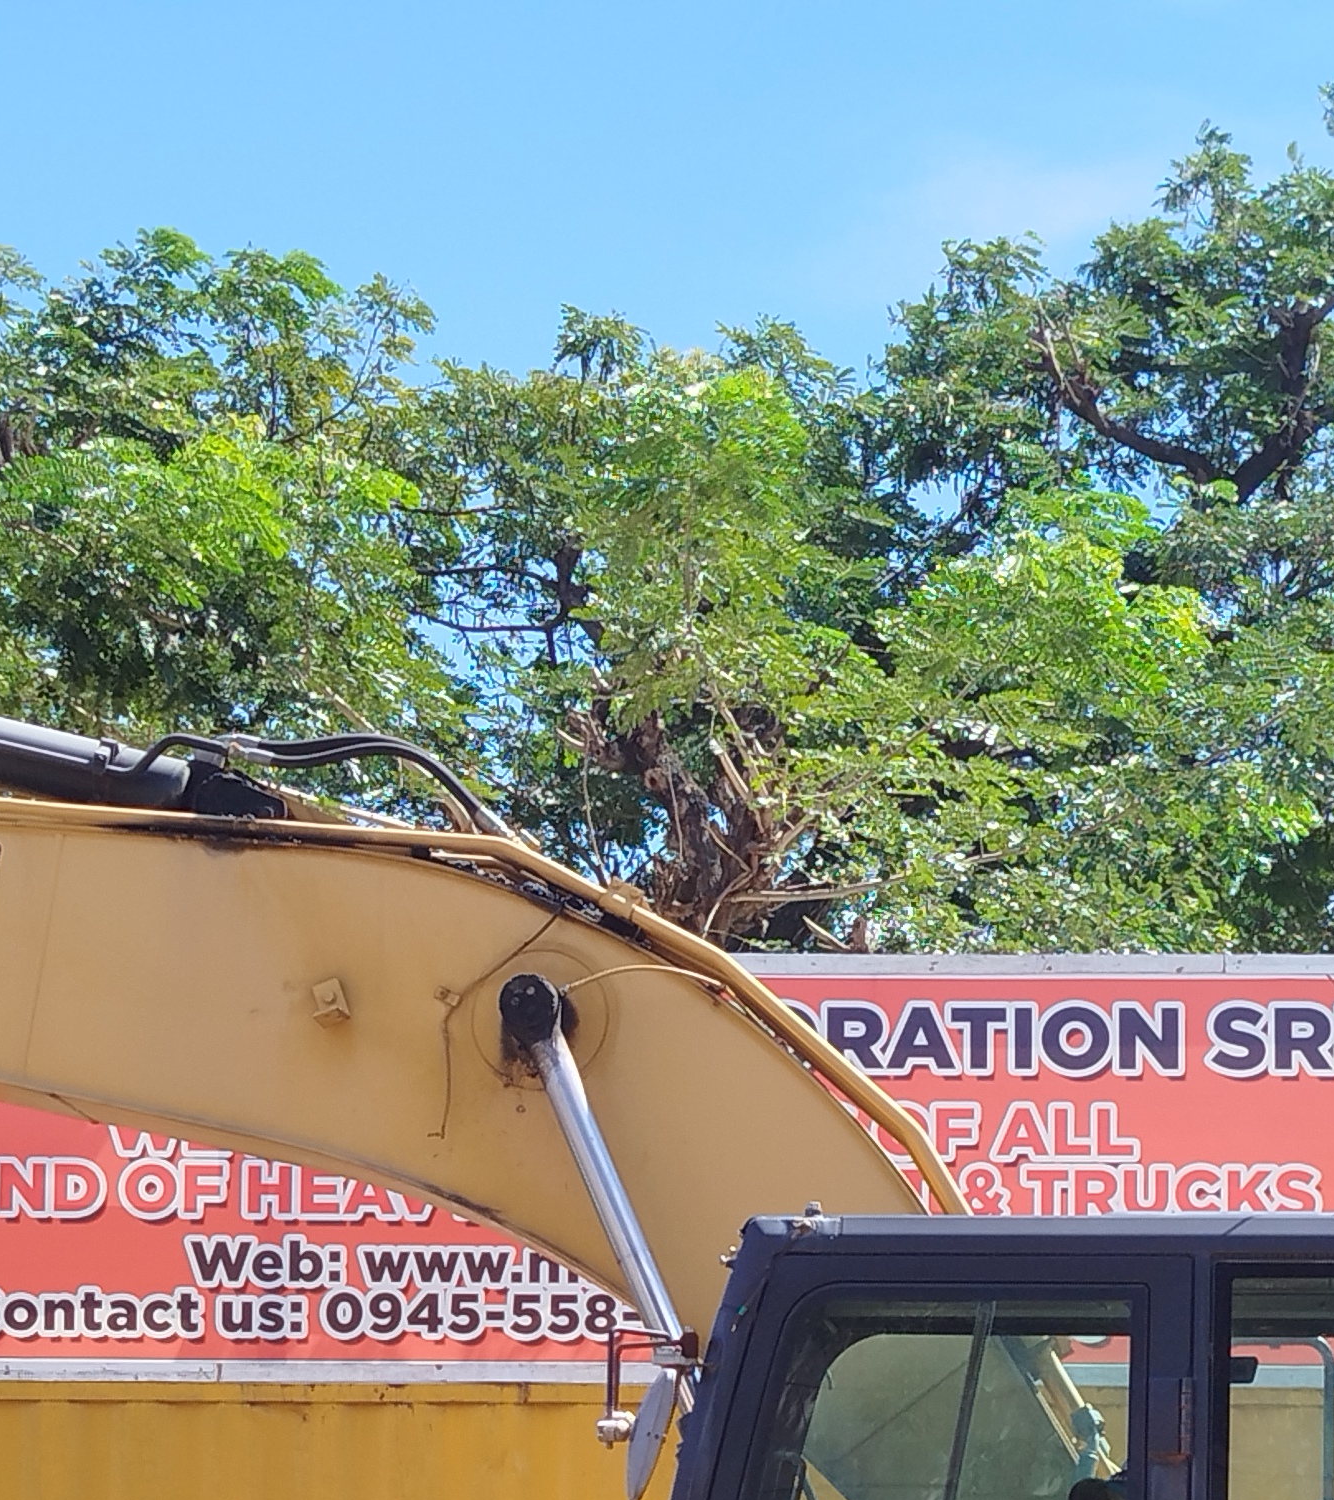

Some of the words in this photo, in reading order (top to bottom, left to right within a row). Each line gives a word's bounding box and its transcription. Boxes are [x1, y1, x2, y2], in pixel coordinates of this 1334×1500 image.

[783, 1000, 1186, 1077] RATION
[989, 1101, 1142, 1164] ALL
[118, 1156, 230, 1221] OF
[1019, 1162, 1325, 1216] TRUCKS
[184, 1234, 347, 1288] Web:
[214, 1294, 309, 1340] us:
